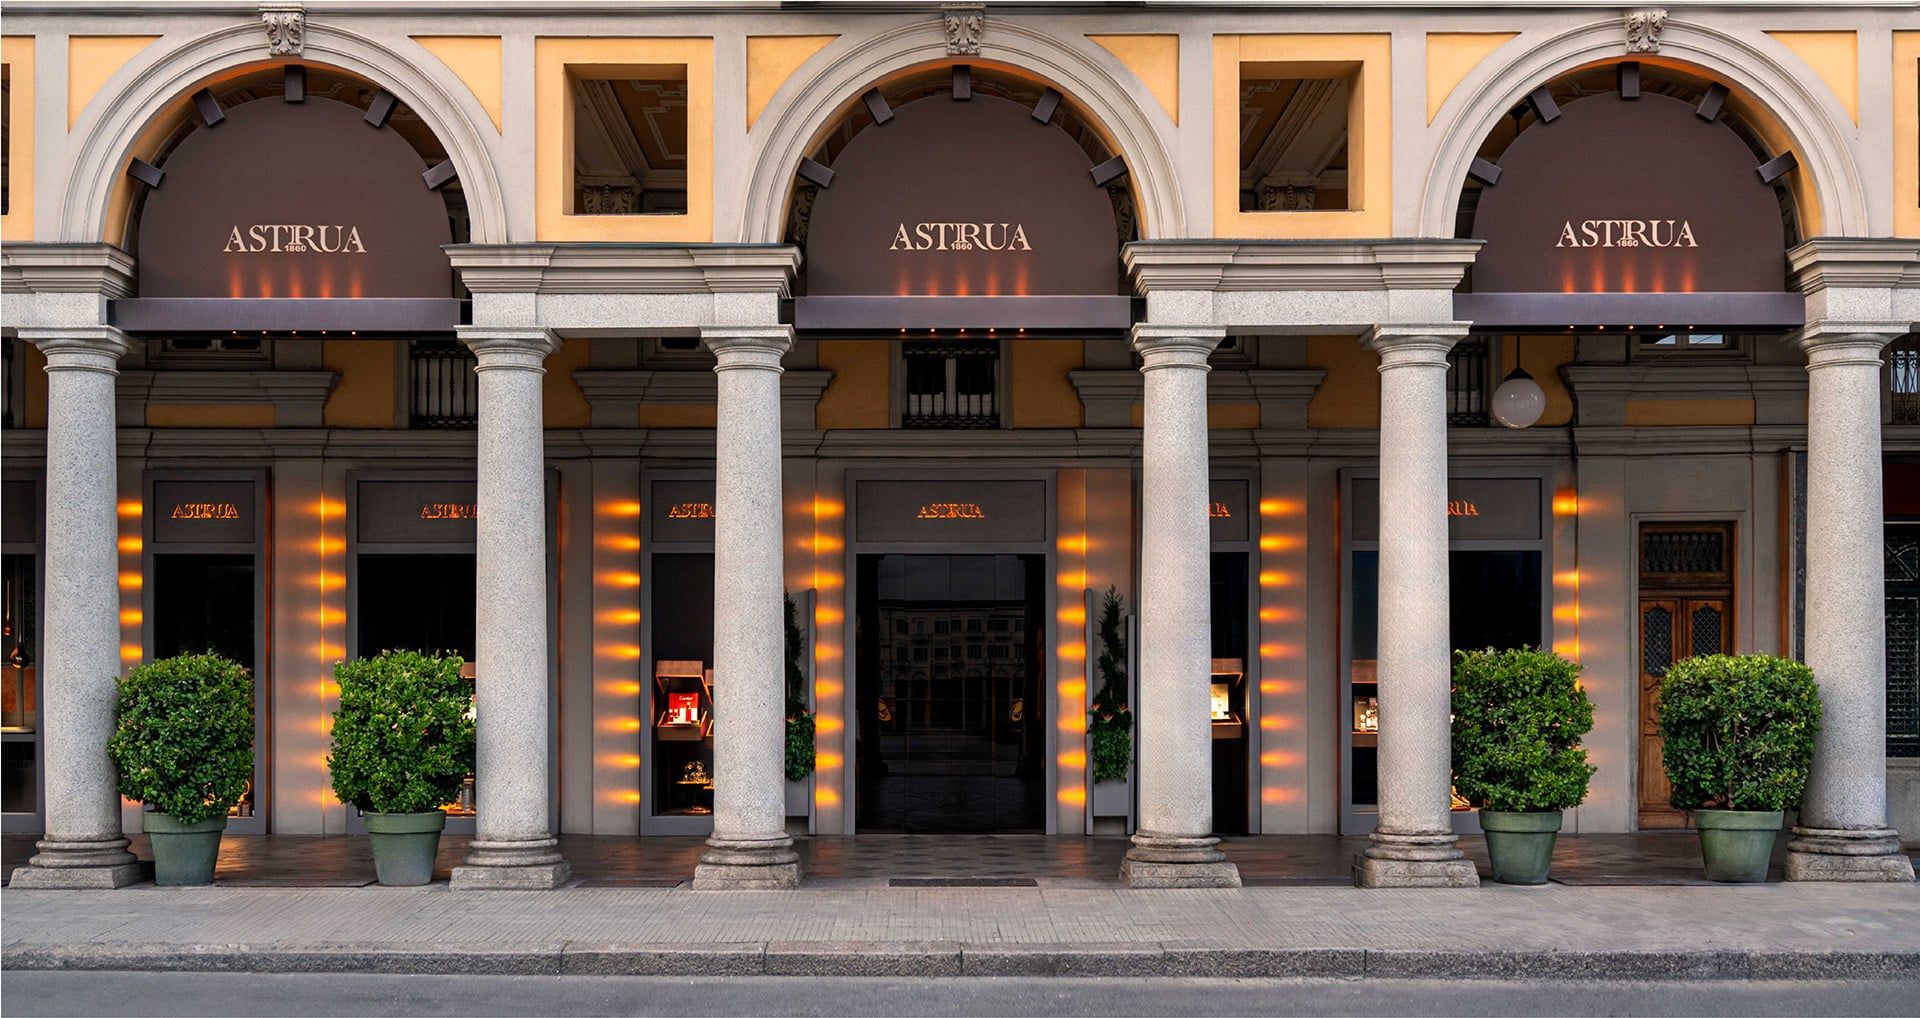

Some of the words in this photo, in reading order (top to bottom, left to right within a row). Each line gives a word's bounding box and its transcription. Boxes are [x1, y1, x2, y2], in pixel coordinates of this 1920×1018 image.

[223, 224, 368, 253] ASTRUA
[889, 222, 1033, 251] ASTRUA
[1555, 219, 1699, 248] ASTRUA
[284, 244, 307, 253] 1860
[950, 242, 973, 251] 1860
[1616, 239, 1639, 248] 1860
[171, 503, 240, 518] ASTRUA
[420, 503, 477, 518] ASTRU
[668, 503, 717, 518] ASTR
[917, 503, 985, 518] ASTRUA
